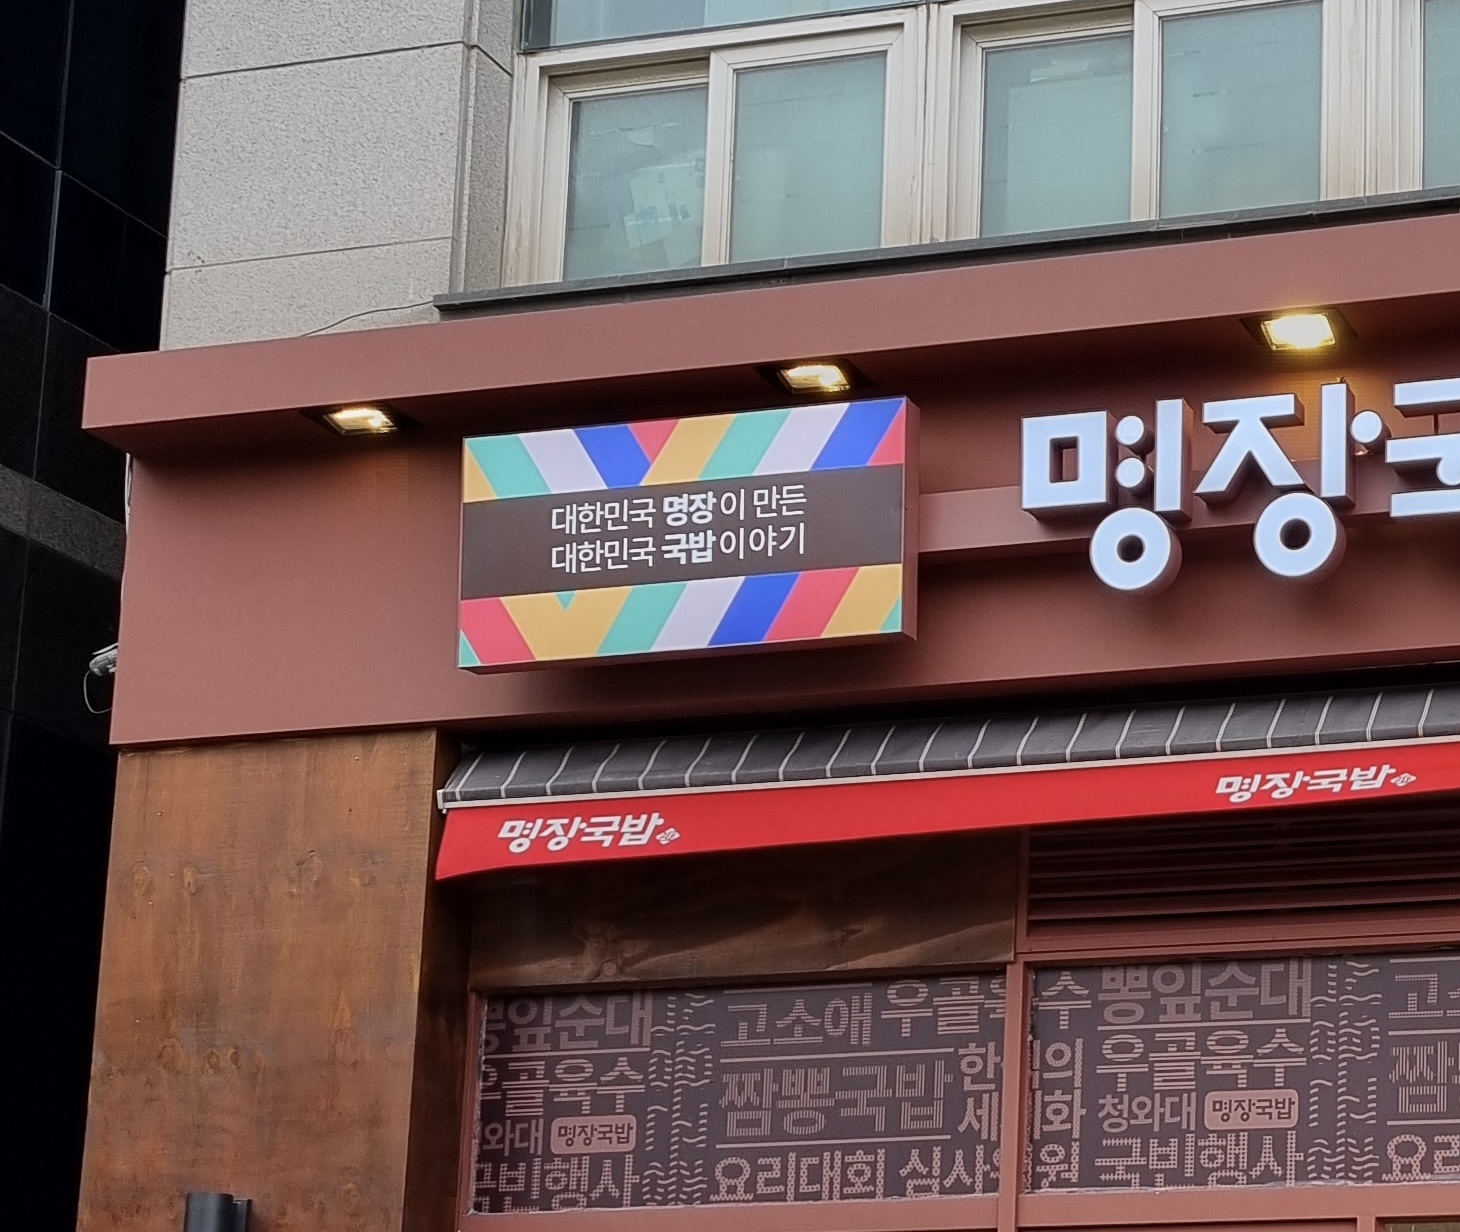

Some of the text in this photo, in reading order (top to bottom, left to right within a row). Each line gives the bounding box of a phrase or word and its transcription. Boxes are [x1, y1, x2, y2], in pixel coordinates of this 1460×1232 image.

[551, 498, 656, 535] 대한민국
[752, 484, 807, 519] 만든
[551, 536, 656, 574] 대한민국
[1215, 764, 1396, 803] 명장국밥
[498, 813, 664, 854] 명장국밥
[1098, 957, 1312, 1024] 뽕잎순대
[720, 993, 873, 1047] 고소애
[1096, 1028, 1307, 1092] 우골육수
[719, 1059, 953, 1138] 짬뽕국밥
[1098, 1092, 1197, 1133] 청와대
[1211, 1098, 1296, 1122] 명장국밥
[557, 1121, 633, 1148] 명장국밥
[709, 1151, 885, 1202] 요리대회
